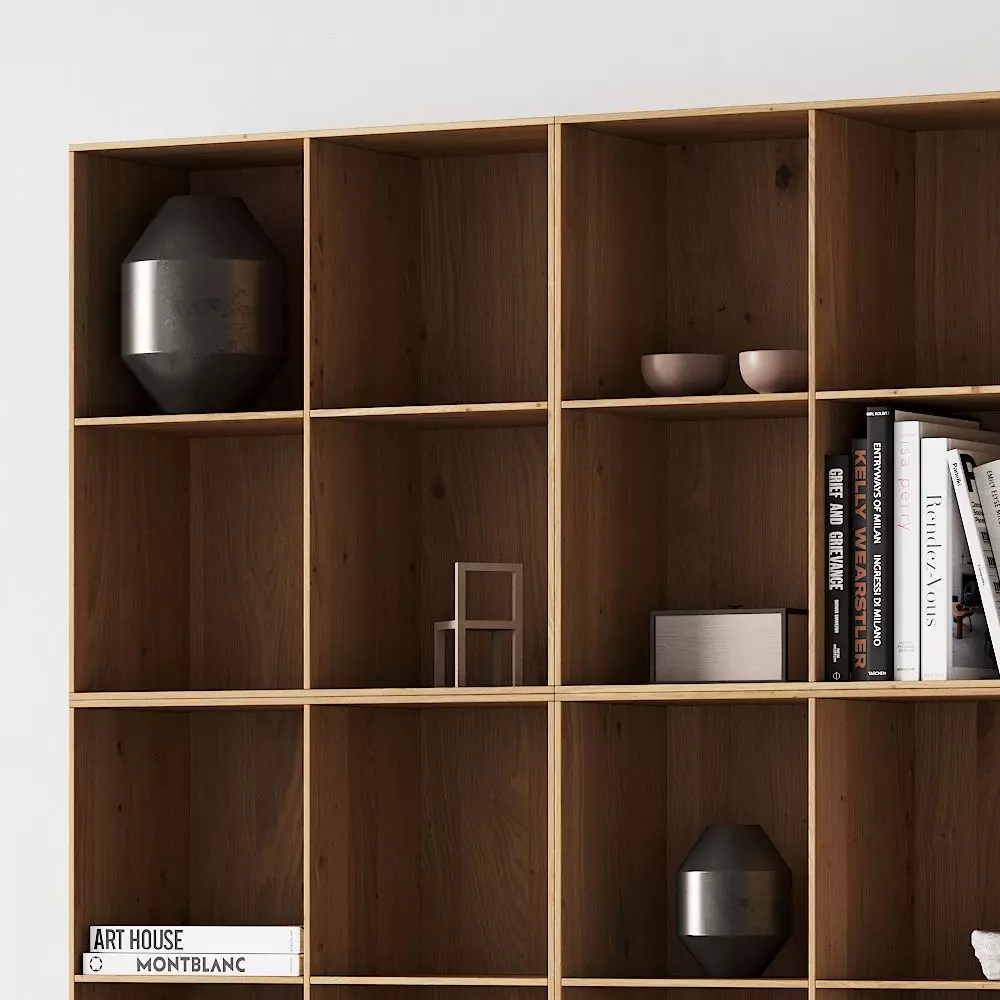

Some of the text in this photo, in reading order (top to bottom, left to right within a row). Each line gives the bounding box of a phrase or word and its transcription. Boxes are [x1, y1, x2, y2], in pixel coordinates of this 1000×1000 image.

[829, 468, 843, 590] GRIEF AND GRIEVANCE
[986, 470, 996, 488] EMILY
[855, 449, 867, 669] KELLY WEARSTLER
[873, 442, 881, 647] ENTRYWAYS OF MILAN INGRESSI DI MILANO
[926, 495, 942, 627] Rendez-Vous
[93, 928, 184, 950] ART HOUSE
[136, 956, 246, 973] MONTBLANC
